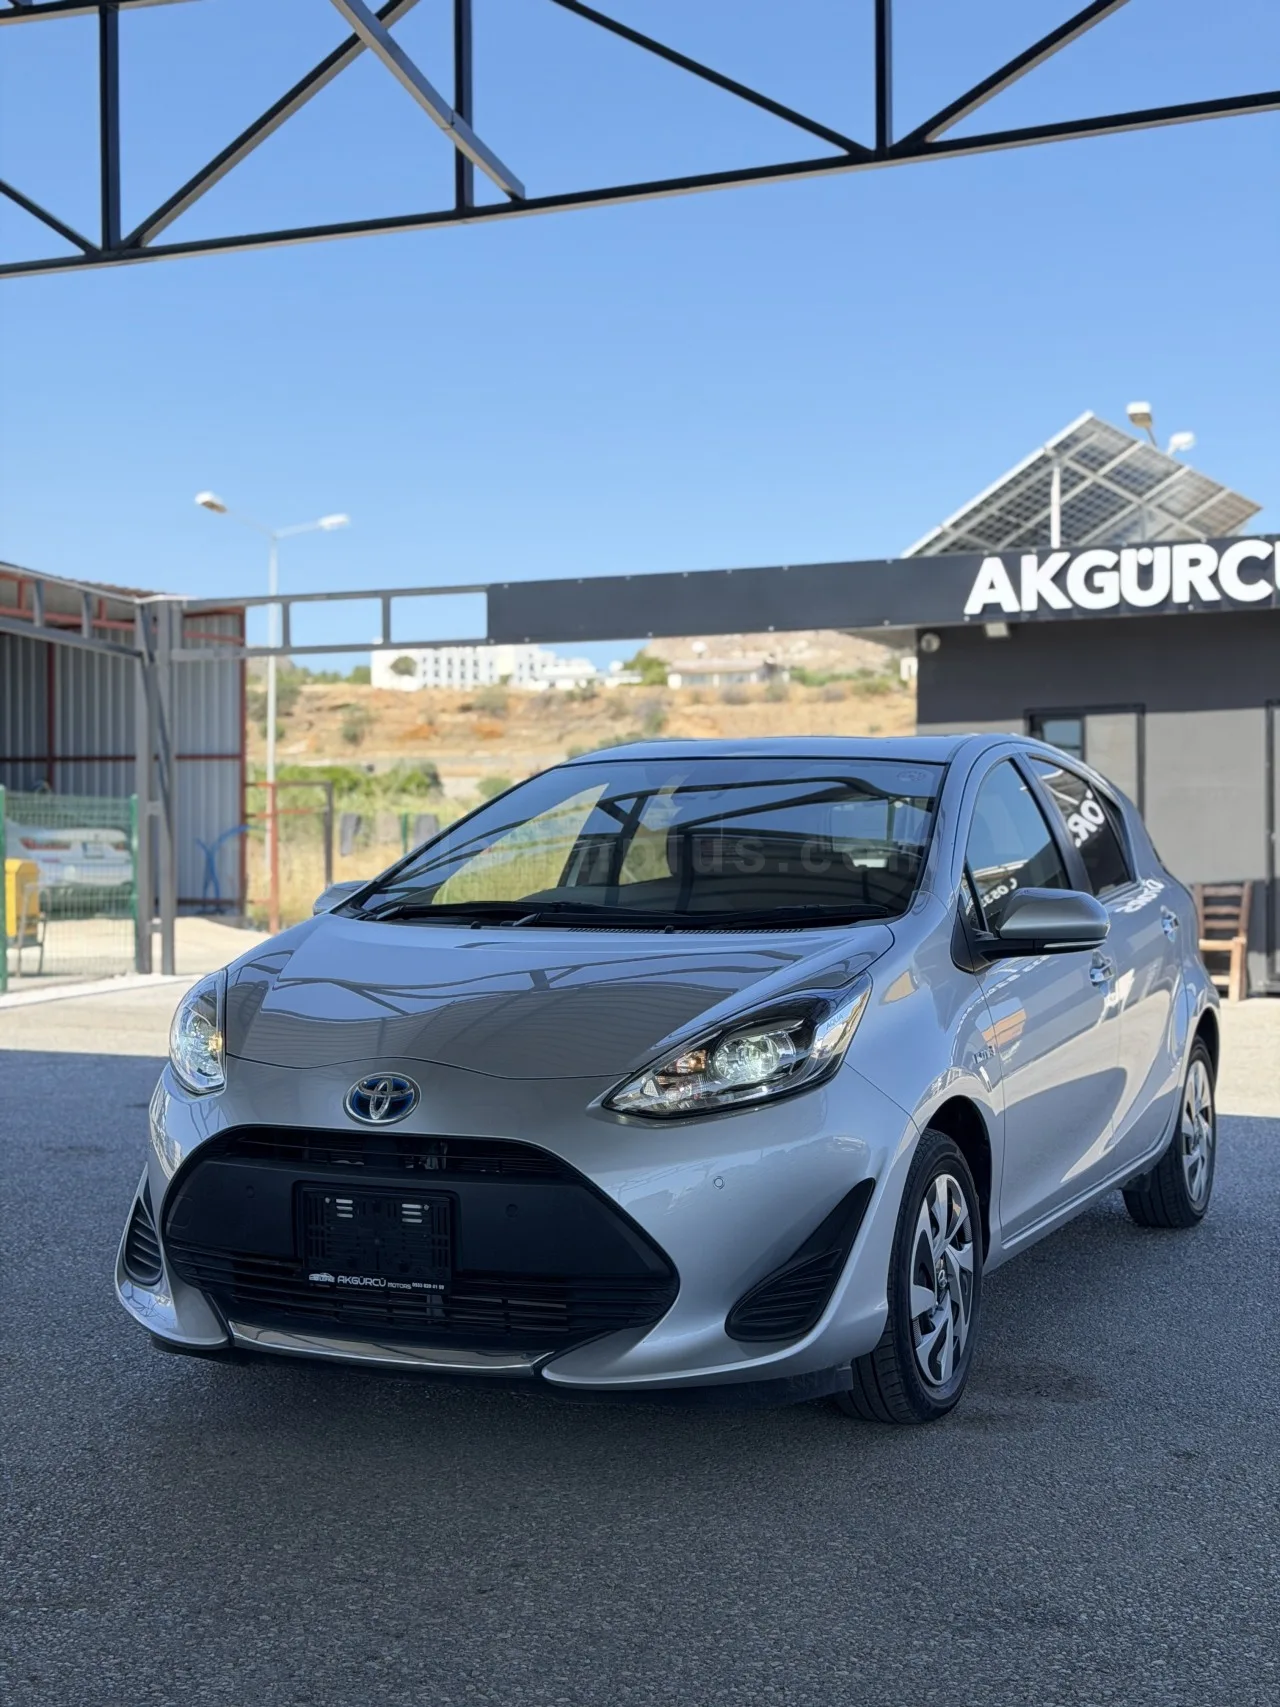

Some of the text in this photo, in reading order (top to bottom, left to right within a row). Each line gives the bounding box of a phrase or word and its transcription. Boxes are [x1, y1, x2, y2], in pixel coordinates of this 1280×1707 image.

[964, 540, 1280, 615] AKGÜRC
[826, 1013, 844, 1030] AQUA
[337, 1275, 387, 1288] AKGÜRCÜ
